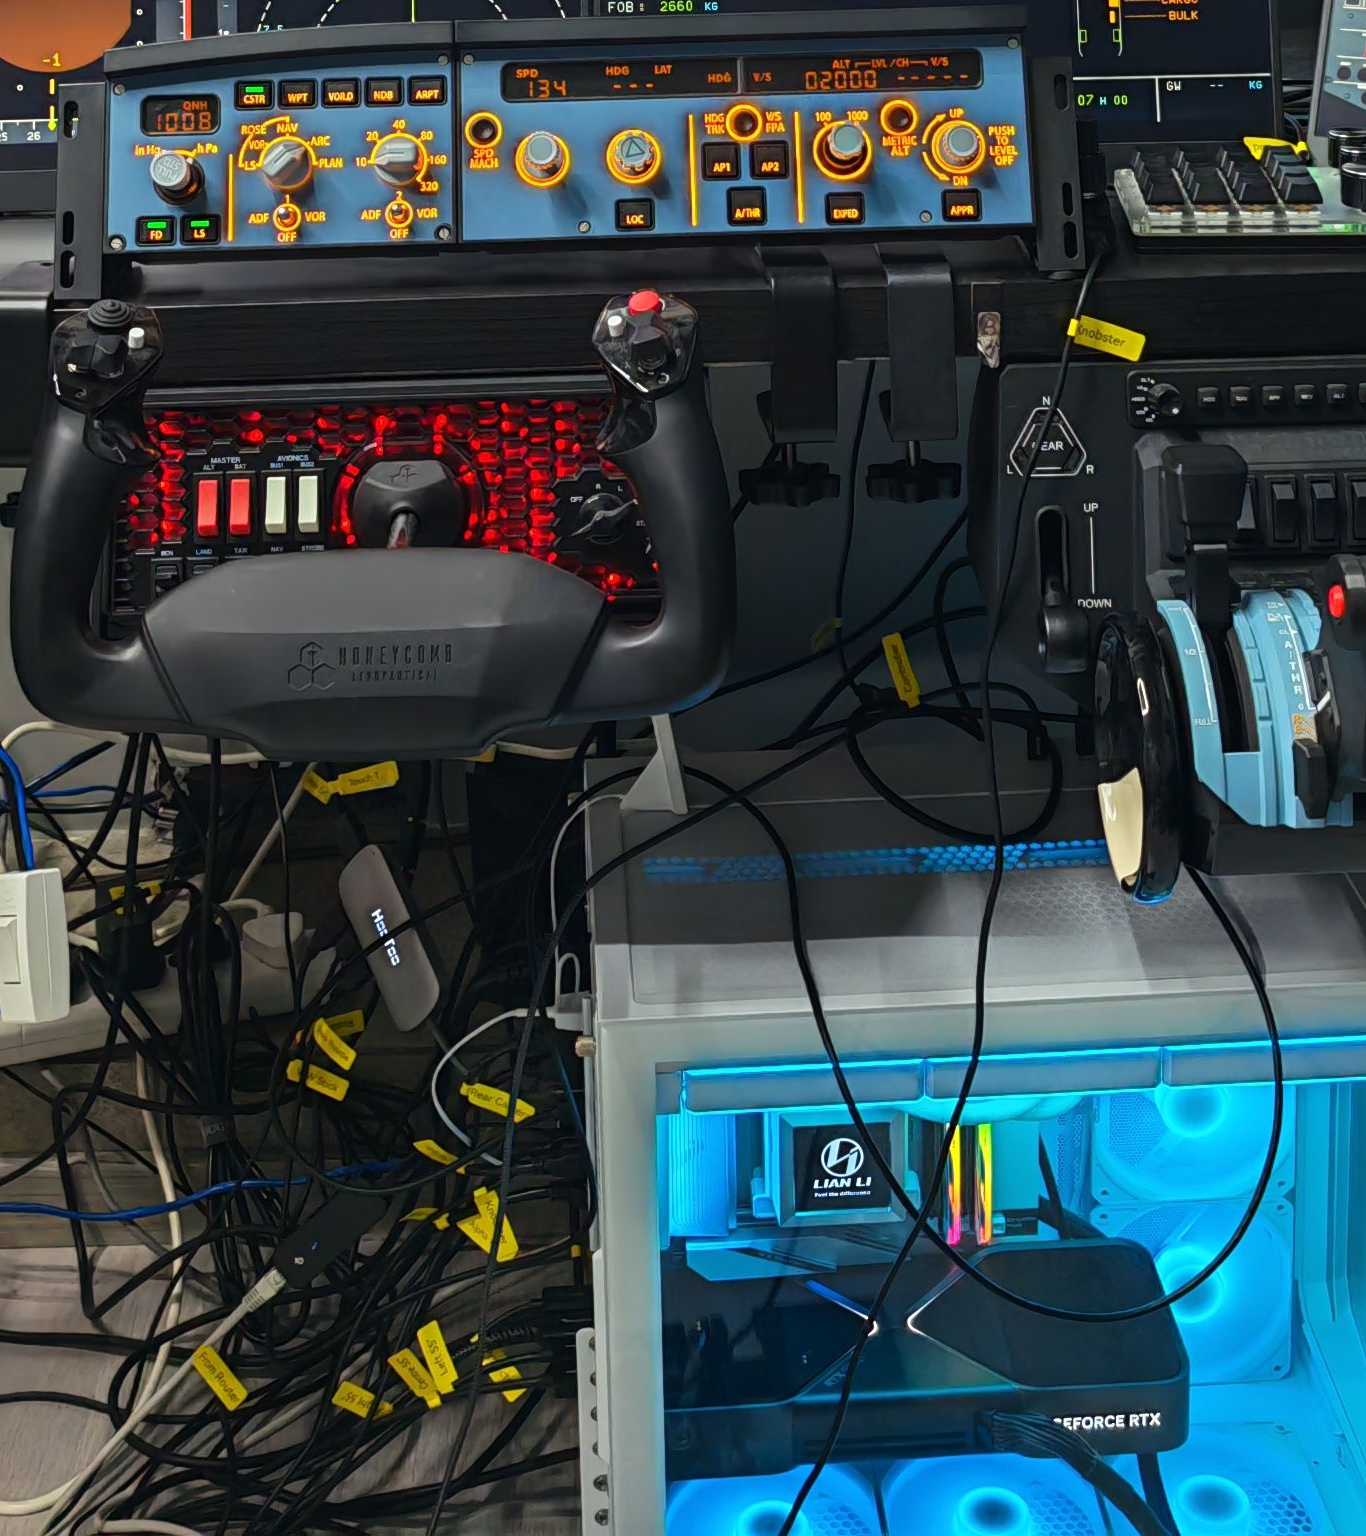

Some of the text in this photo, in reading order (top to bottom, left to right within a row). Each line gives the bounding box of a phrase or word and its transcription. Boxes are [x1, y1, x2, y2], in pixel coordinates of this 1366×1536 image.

[607, 1, 718, 13] FOB 2660 KG
[1168, 11, 1199, 21] BULK
[805, 71, 877, 90] 02000
[1166, 81, 1262, 91] GW KG
[415, 88, 439, 100] ARPT
[526, 79, 567, 98] 134
[243, 92, 265, 105] CSTR
[288, 92, 308, 103] WPT
[373, 89, 394, 101] NDB
[183, 100, 208, 112] QNH
[156, 112, 211, 130] 1008
[713, 162, 731, 173] AP1
[761, 161, 780, 172] AP2
[950, 205, 974, 216] APPR
[626, 214, 644, 225] LOC
[1083, 502, 1099, 512] UP
[1077, 598, 1112, 609] DOWN
[813, 1176, 872, 1189] LIAN LI
[1127, 1411, 1162, 1429] RTX
